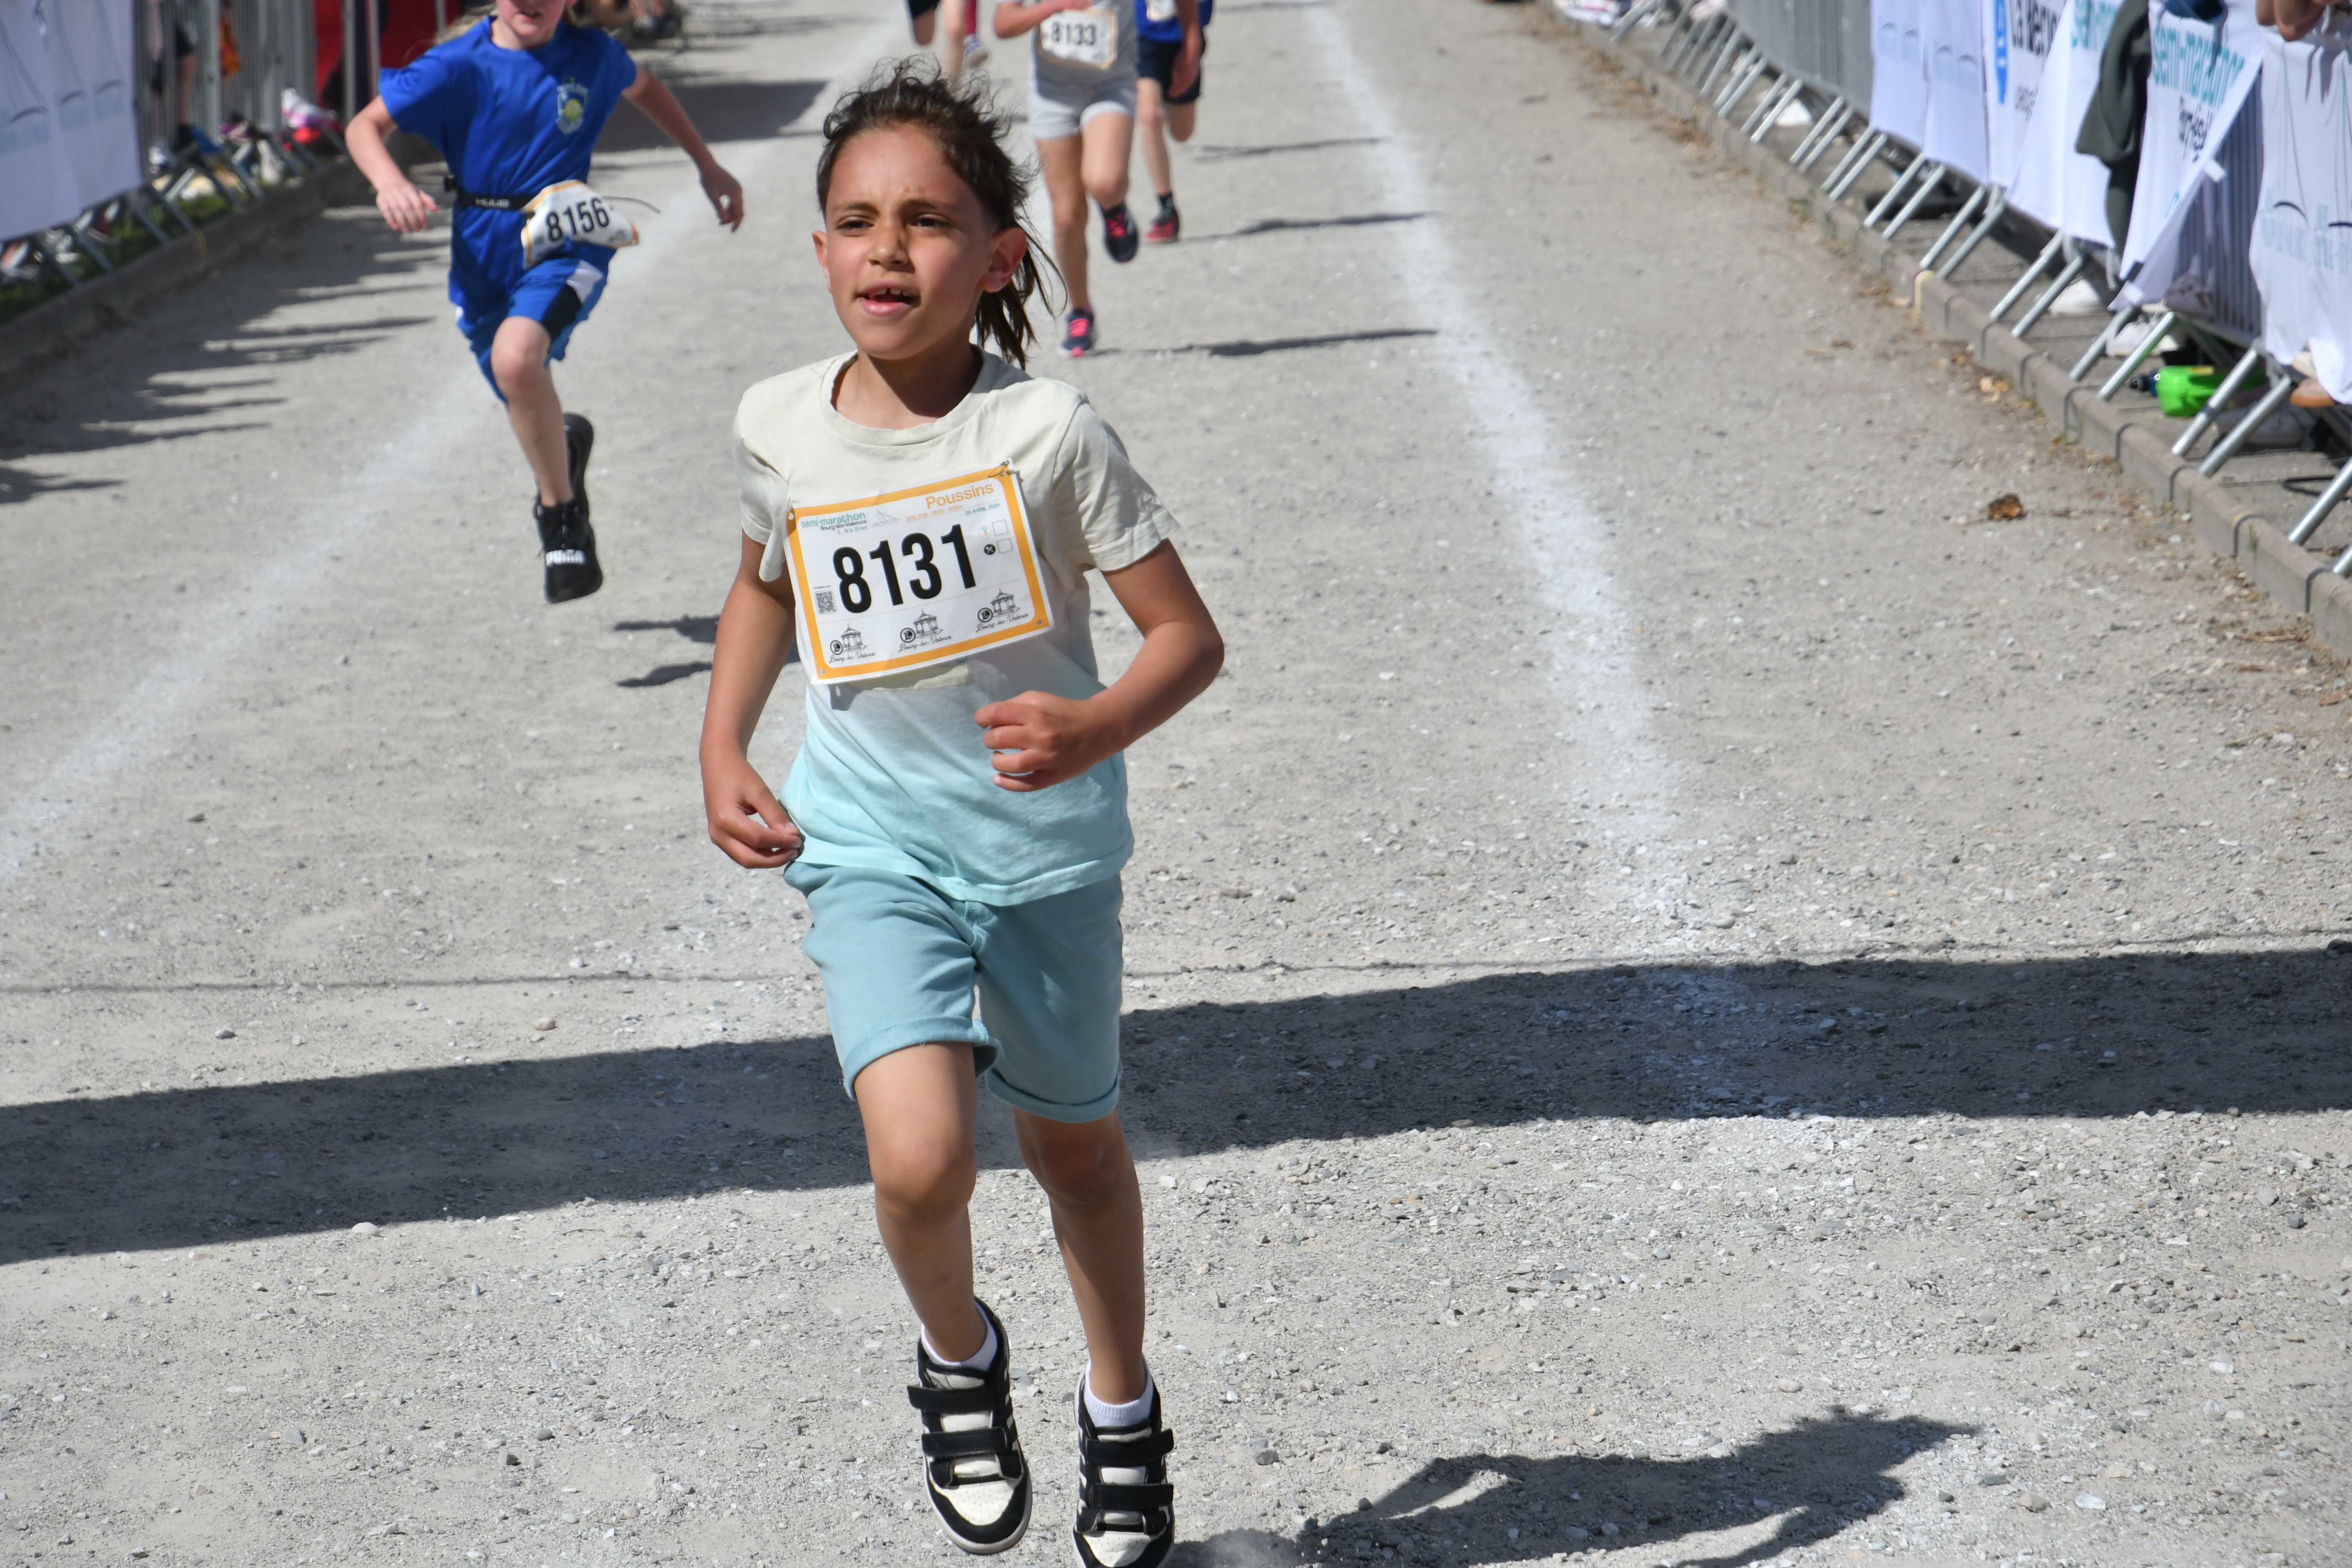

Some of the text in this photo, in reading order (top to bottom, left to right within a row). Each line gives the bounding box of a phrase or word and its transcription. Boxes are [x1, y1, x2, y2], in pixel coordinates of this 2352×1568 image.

[1051, 22, 1096, 45] 8133
[546, 197, 610, 241] 8156
[926, 484, 994, 509] Poussins
[801, 512, 866, 528] semi-marathon
[833, 524, 976, 613] 8131
